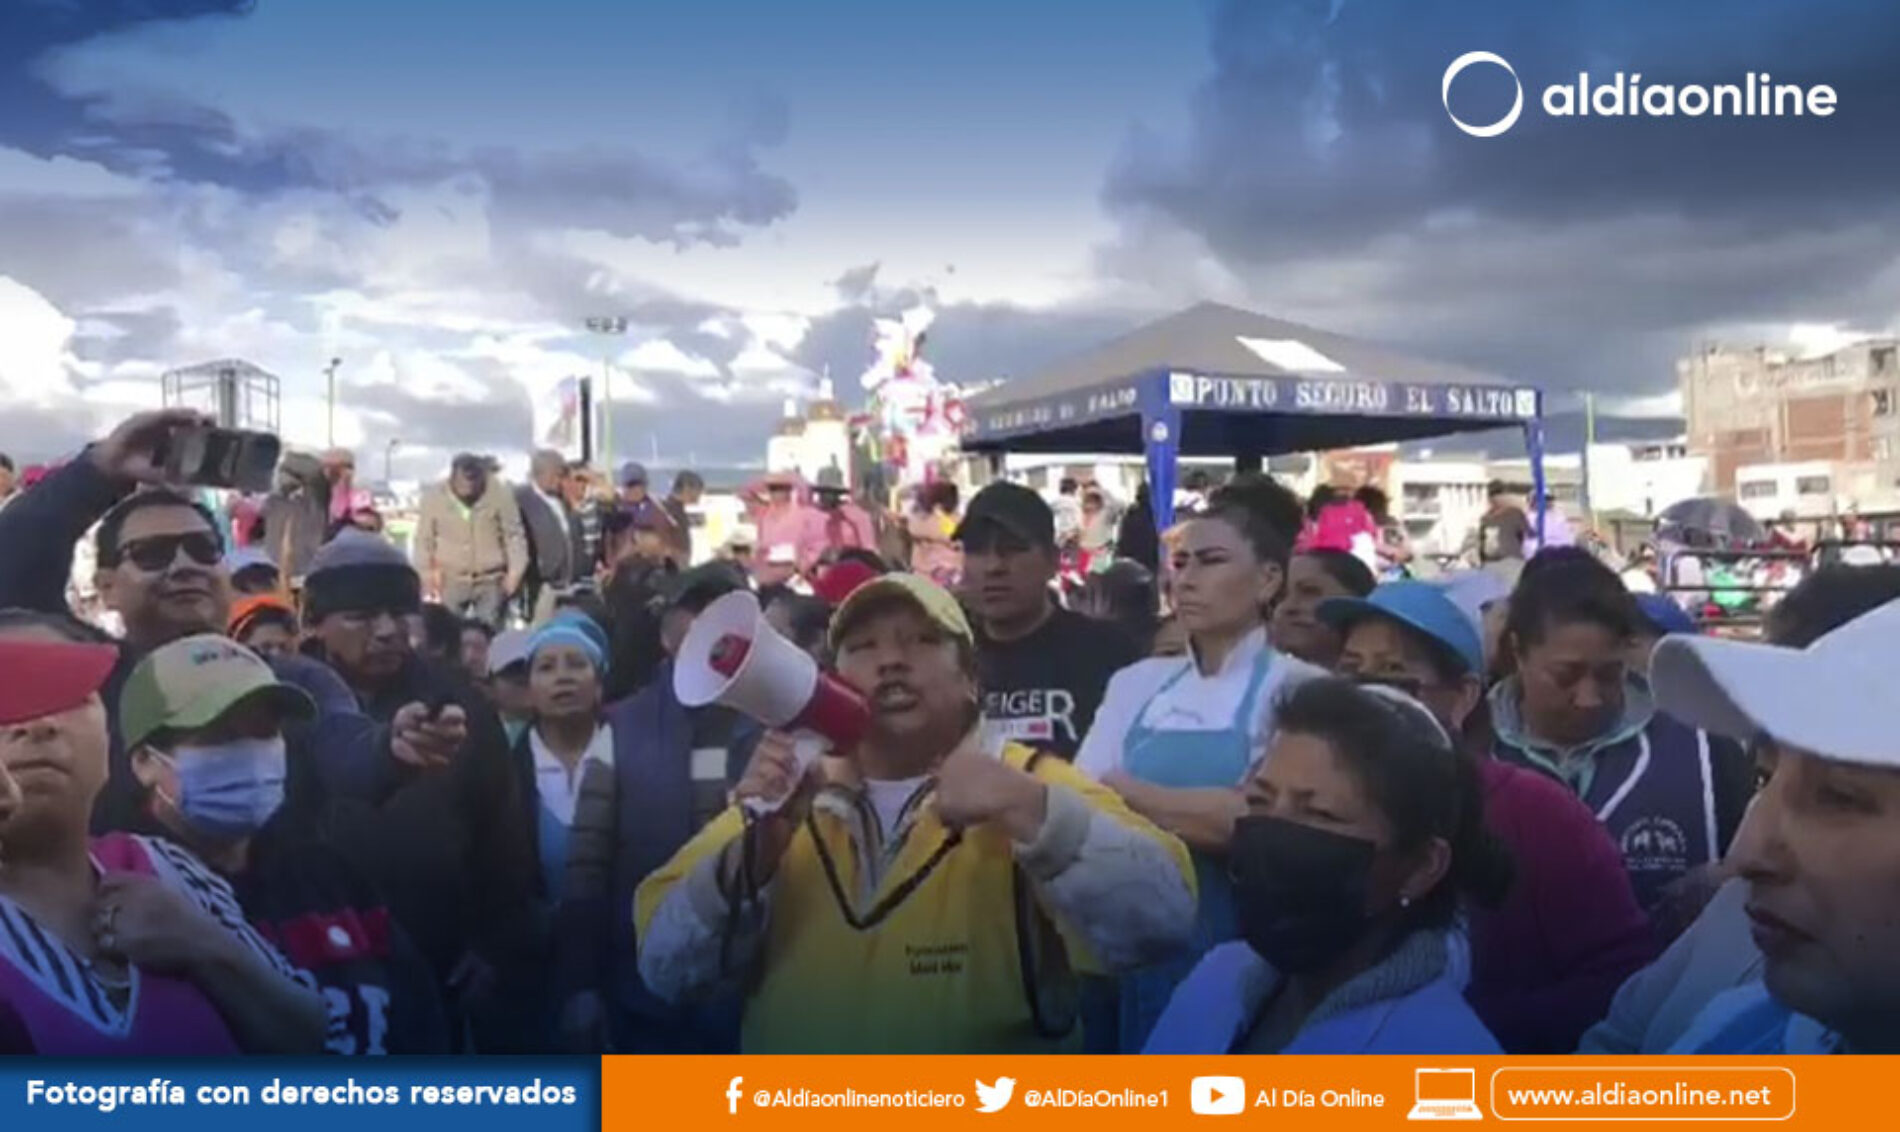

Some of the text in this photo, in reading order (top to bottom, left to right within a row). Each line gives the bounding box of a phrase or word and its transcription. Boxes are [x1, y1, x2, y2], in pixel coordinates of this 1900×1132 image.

[1196, 376, 1512, 416] PUNTO SEGURO EL SALTO
